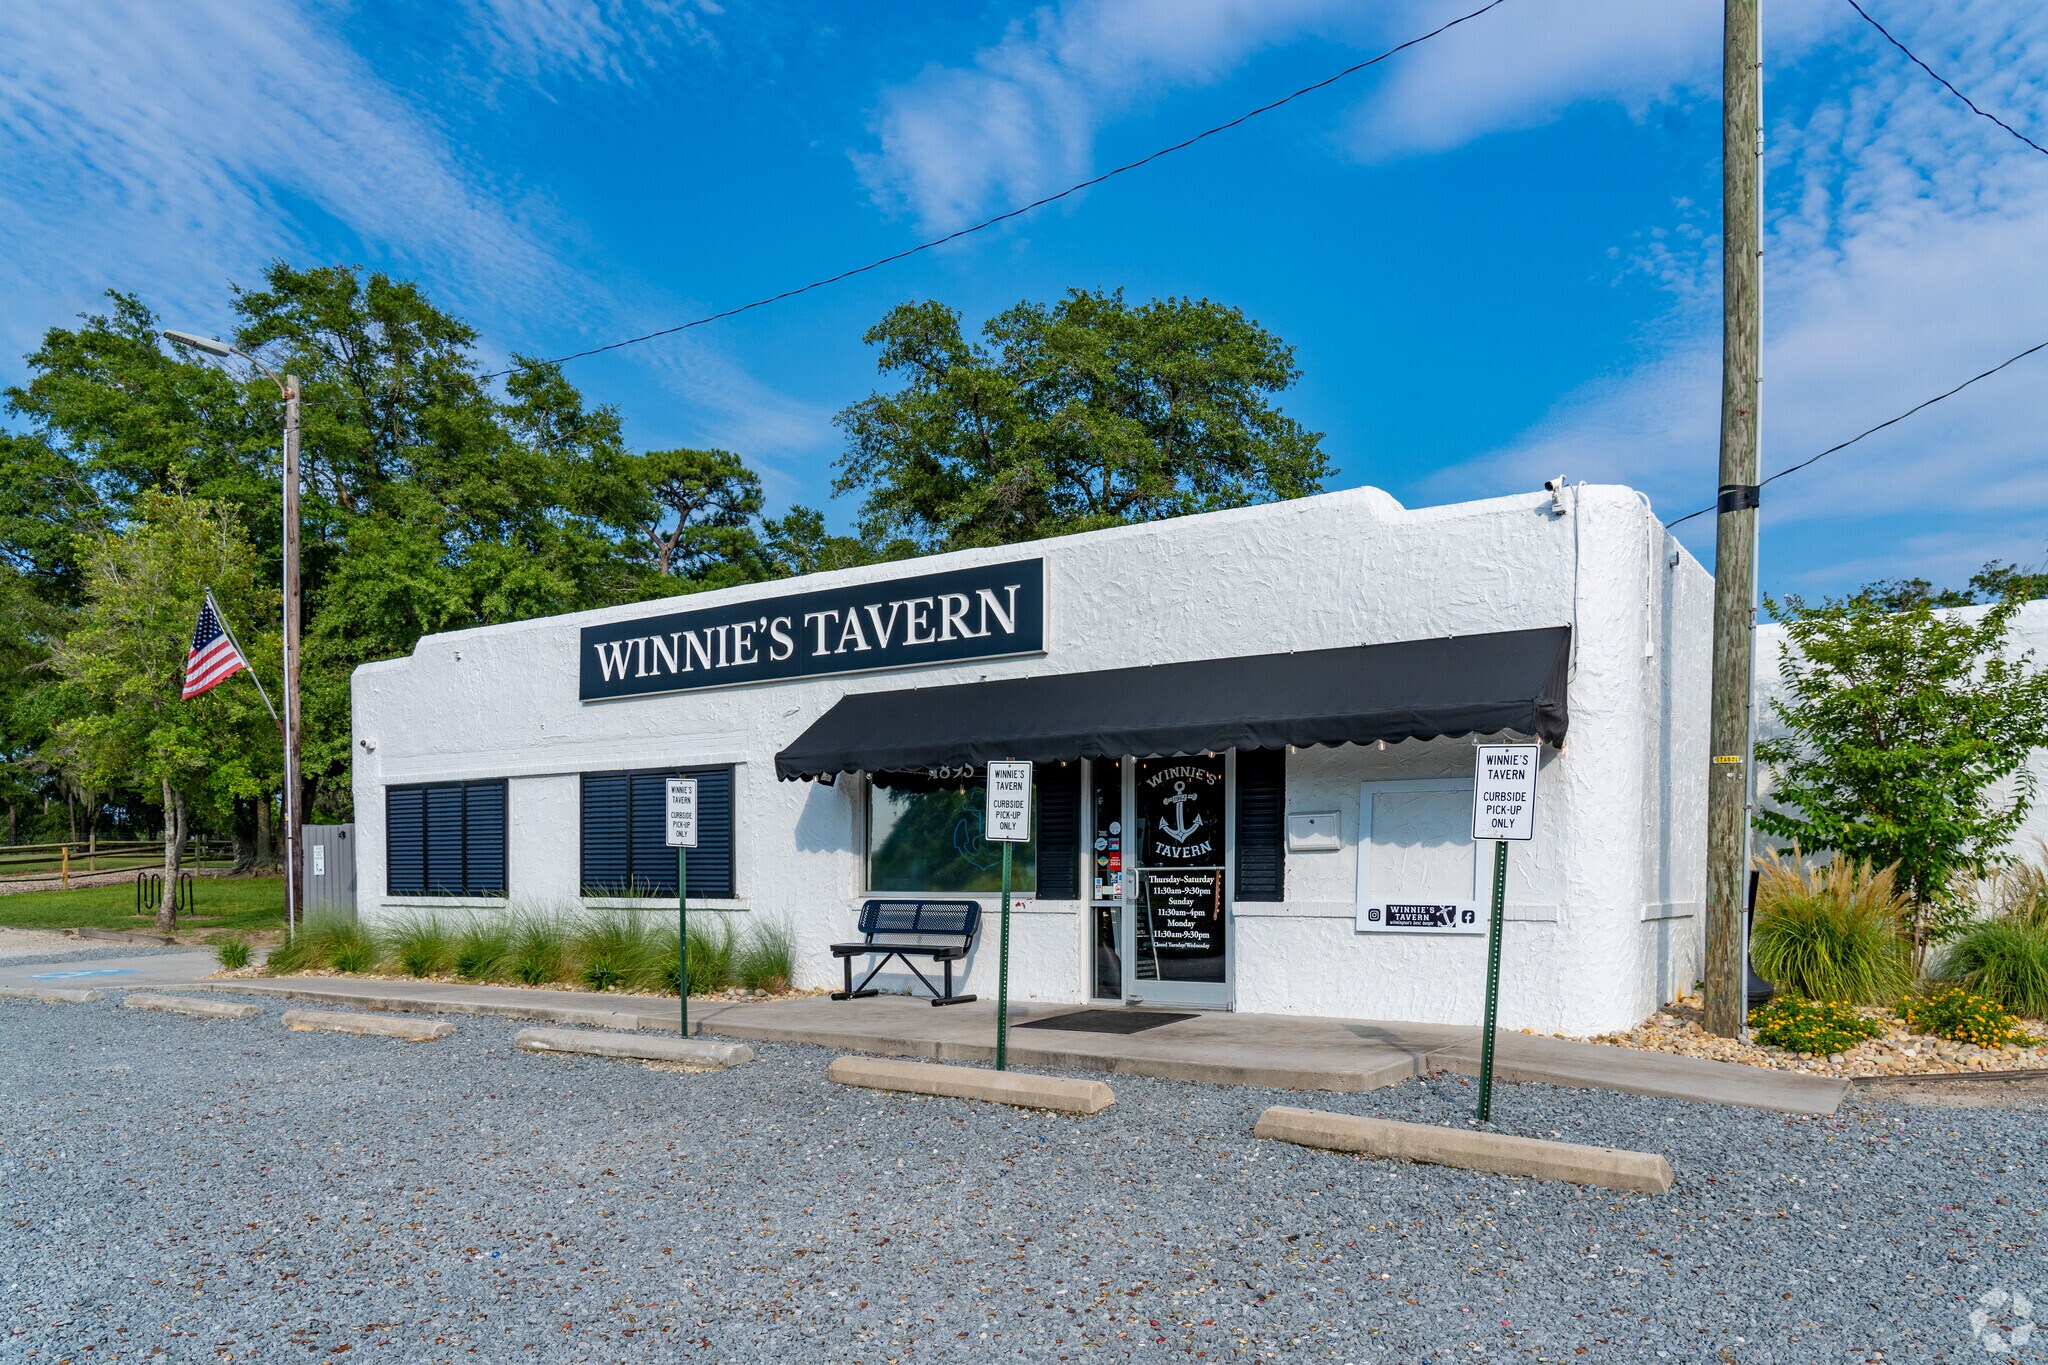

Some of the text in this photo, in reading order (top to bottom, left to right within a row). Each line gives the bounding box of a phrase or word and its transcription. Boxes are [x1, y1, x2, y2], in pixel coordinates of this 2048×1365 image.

[593, 584, 1021, 682] WINNIE’S TAVERN
[1486, 754, 1529, 766] WINNIE'S
[994, 769, 1025, 779] WINNIE'S
[1146, 766, 1217, 788] WINNIE'S
[1488, 769, 1526, 780] TAVERN
[671, 786, 693, 794] WINNIE'S
[996, 781, 1023, 791] TAVERN
[672, 796, 692, 804] TAVERN
[1483, 791, 1527, 802] CURBSIDE
[993, 799, 1024, 809] CURBSIDE
[670, 811, 693, 819] CURBSIDE
[995, 810, 1021, 820] PICK-UP
[1486, 805, 1522, 815] PICK-UP
[999, 821, 1017, 831] ONLY
[1491, 818, 1515, 829] ONLY
[675, 830, 688, 838] ONLY
[1155, 840, 1213, 858] TAVERN
[1168, 897, 1195, 907] Sunday
[1390, 906, 1435, 914] WINNIE'S
[1395, 913, 1430, 921] TAVERN
[1167, 919, 1196, 929] Monday
[1153, 930, 1211, 941] 11:30am-9:30pm
